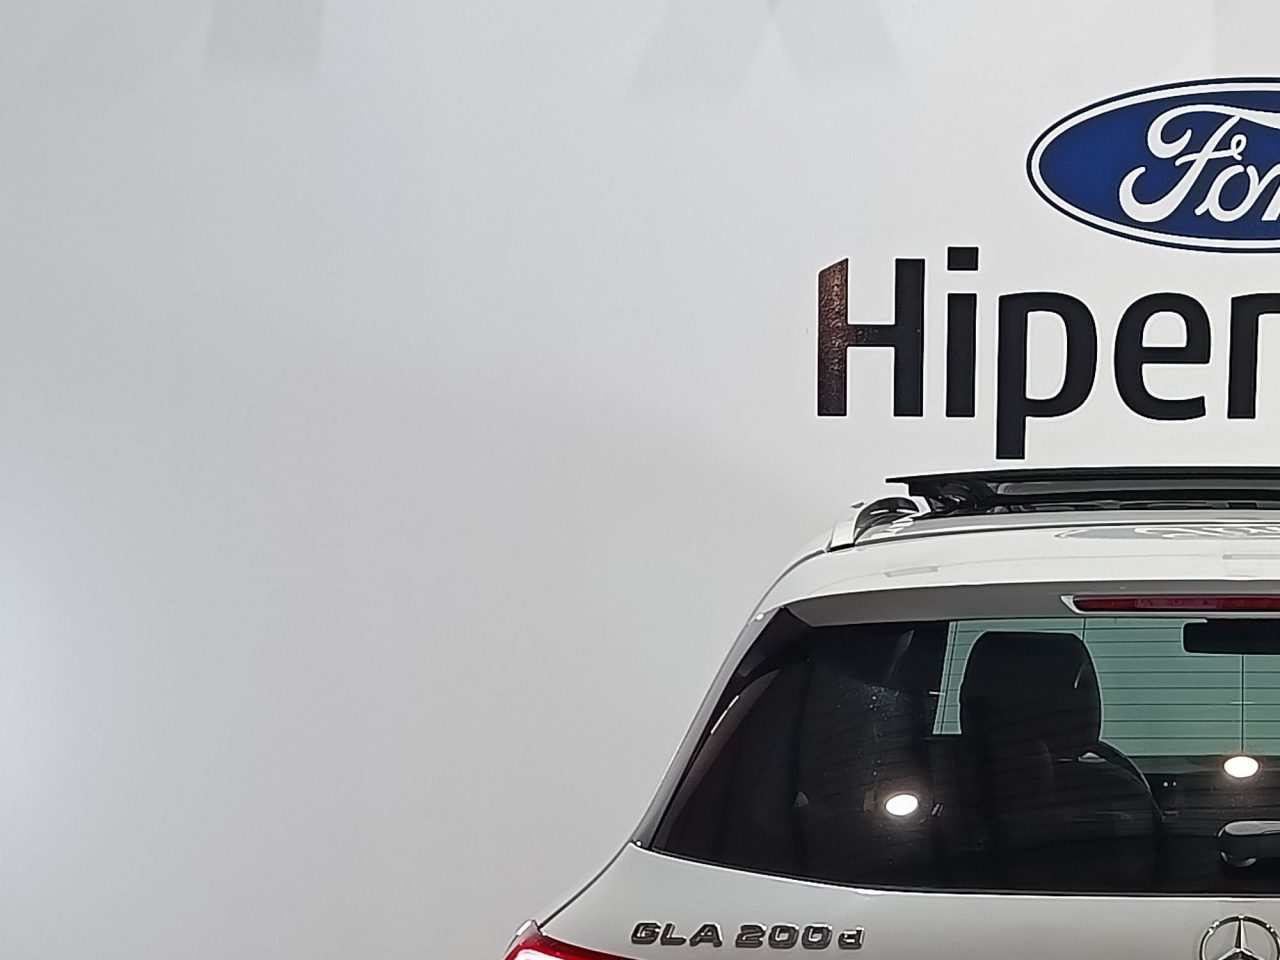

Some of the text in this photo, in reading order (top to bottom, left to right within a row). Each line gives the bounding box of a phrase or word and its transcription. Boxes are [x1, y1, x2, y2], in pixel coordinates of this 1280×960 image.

[631, 921, 866, 950] GLA 200 d
